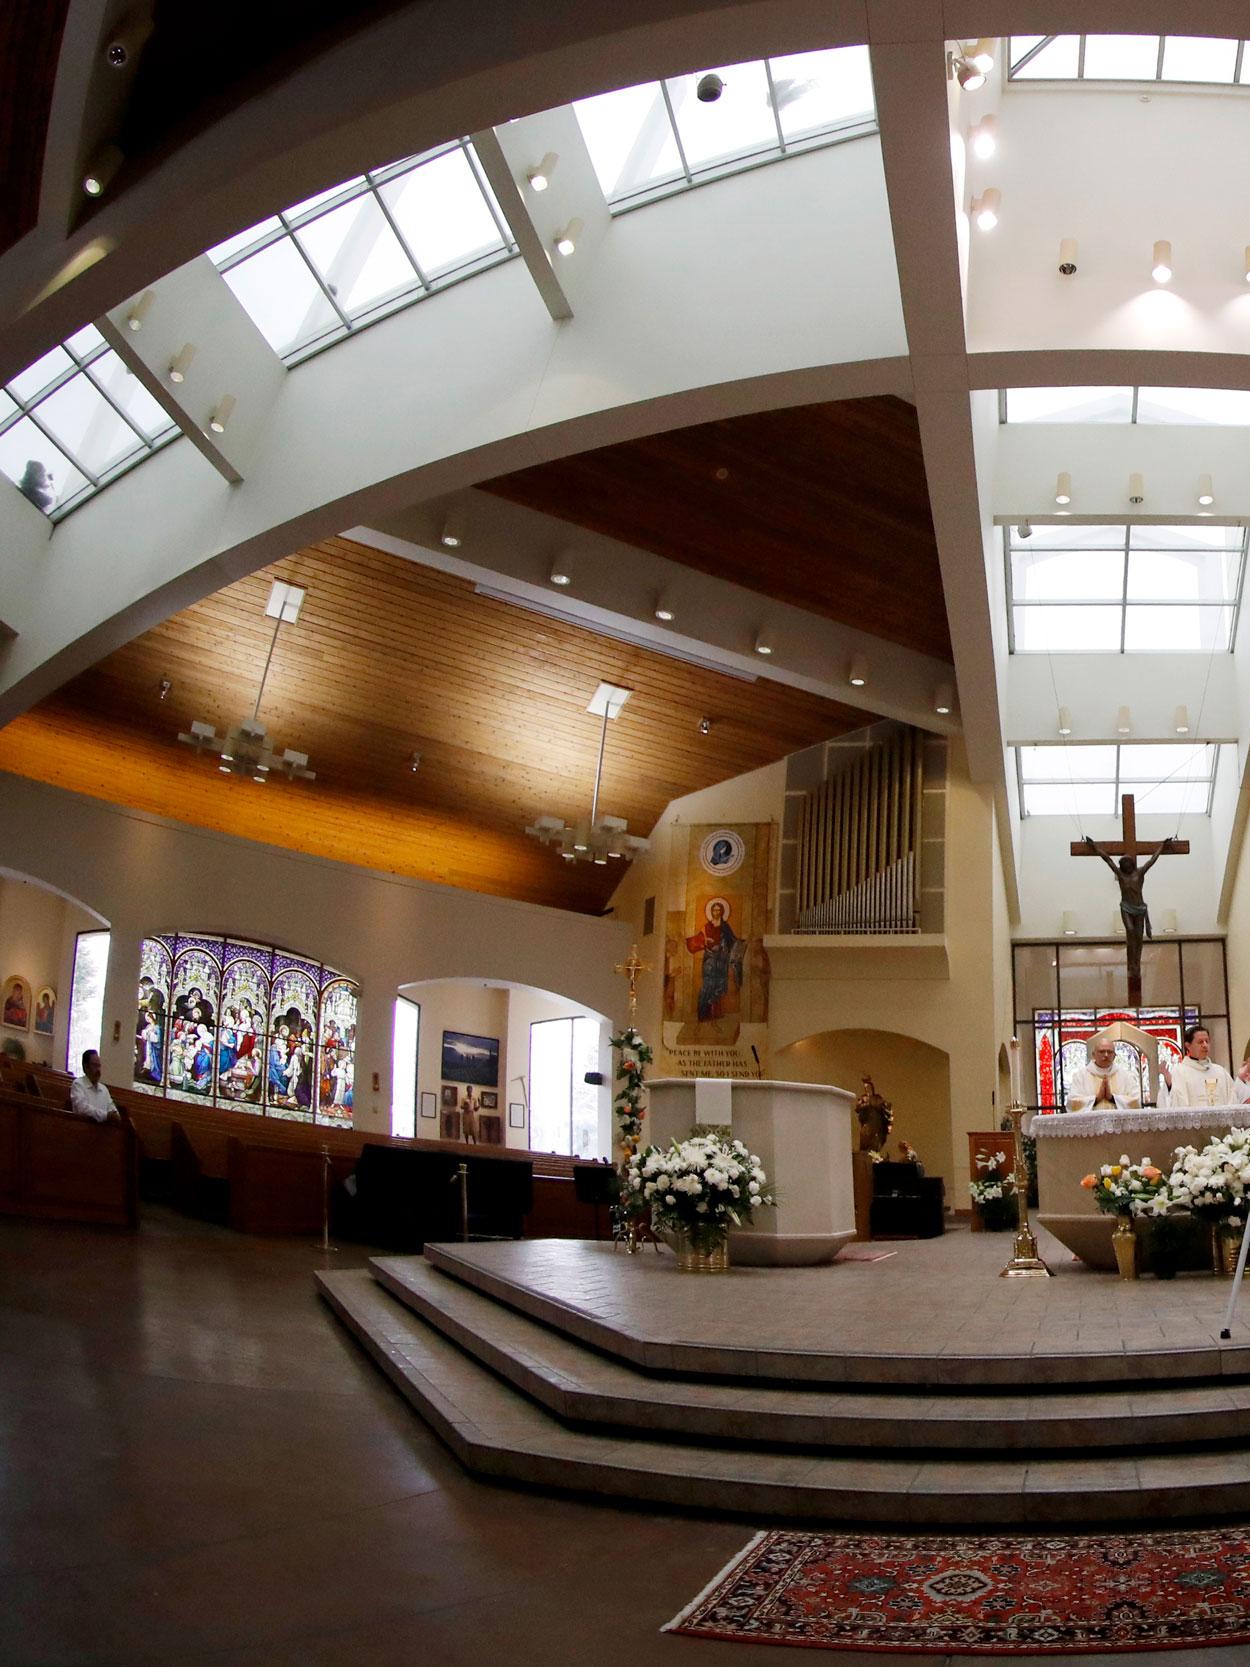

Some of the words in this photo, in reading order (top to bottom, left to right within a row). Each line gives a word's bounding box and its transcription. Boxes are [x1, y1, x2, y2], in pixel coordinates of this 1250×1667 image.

[693, 1049, 701, 1057] BE
[703, 1049, 724, 1057] WITH
[678, 1059, 687, 1067] AS
[689, 1059, 702, 1067] THE
[703, 1059, 731, 1068] FATHER
[732, 1060, 748, 1068] HAS
[681, 1069, 699, 1078] SENT
[731, 1070, 750, 1078] SEND
